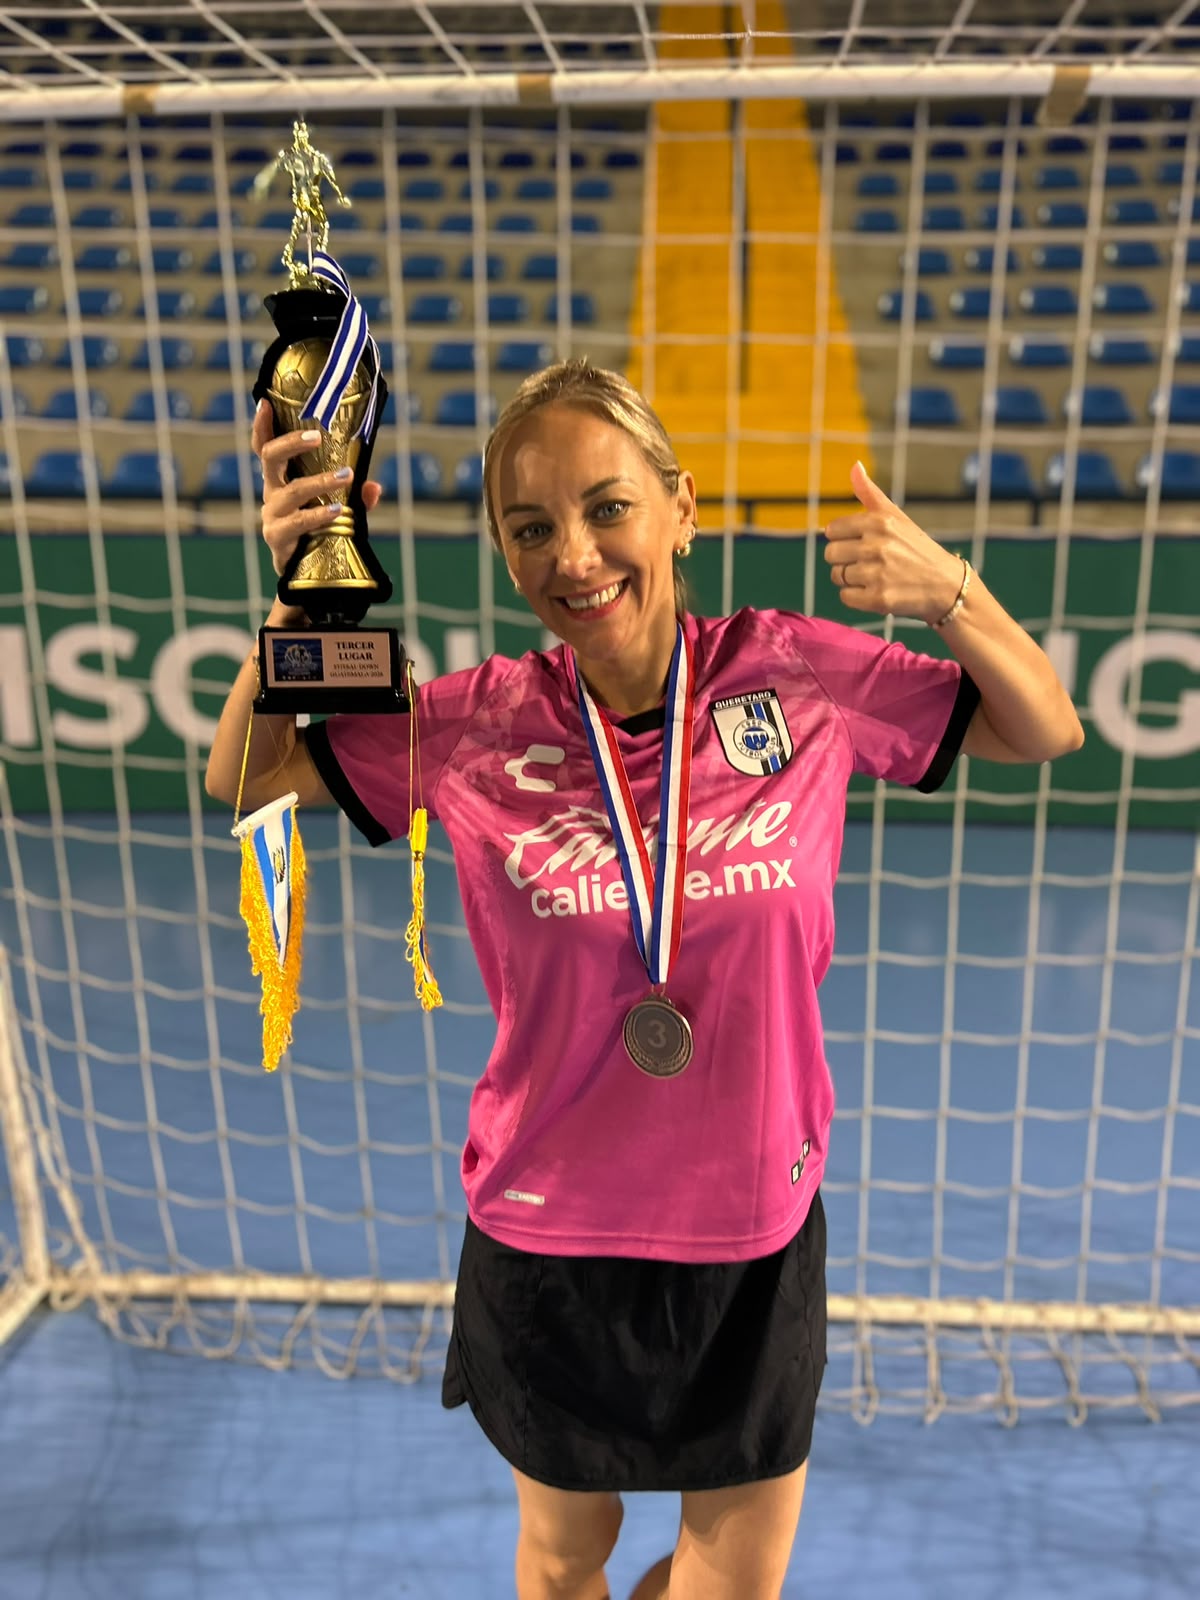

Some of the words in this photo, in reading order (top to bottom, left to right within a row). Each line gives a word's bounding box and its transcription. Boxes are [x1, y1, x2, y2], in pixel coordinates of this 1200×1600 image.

[334, 641, 375, 650] TERCER
[338, 652, 373, 661] LUGAR
[715, 691, 771, 709] QUERETARO
[531, 858, 797, 919] caliee.mx
[647, 1019, 666, 1049] 3
